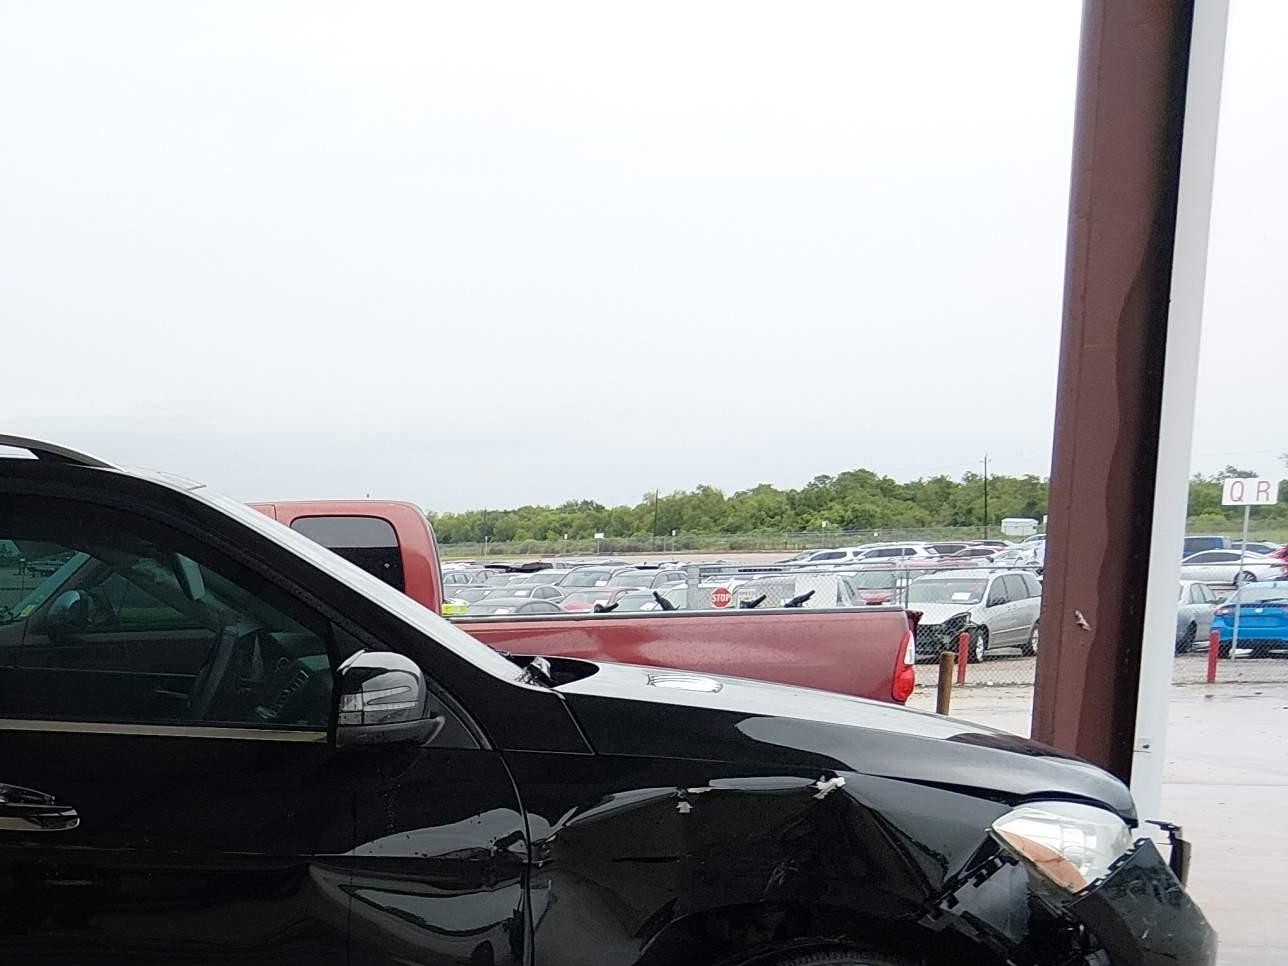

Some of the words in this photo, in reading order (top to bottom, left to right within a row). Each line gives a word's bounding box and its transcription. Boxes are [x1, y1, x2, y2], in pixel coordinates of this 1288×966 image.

[1230, 480, 1245, 503] Q
[1255, 480, 1271, 502] R
[712, 593, 731, 603] STOP
